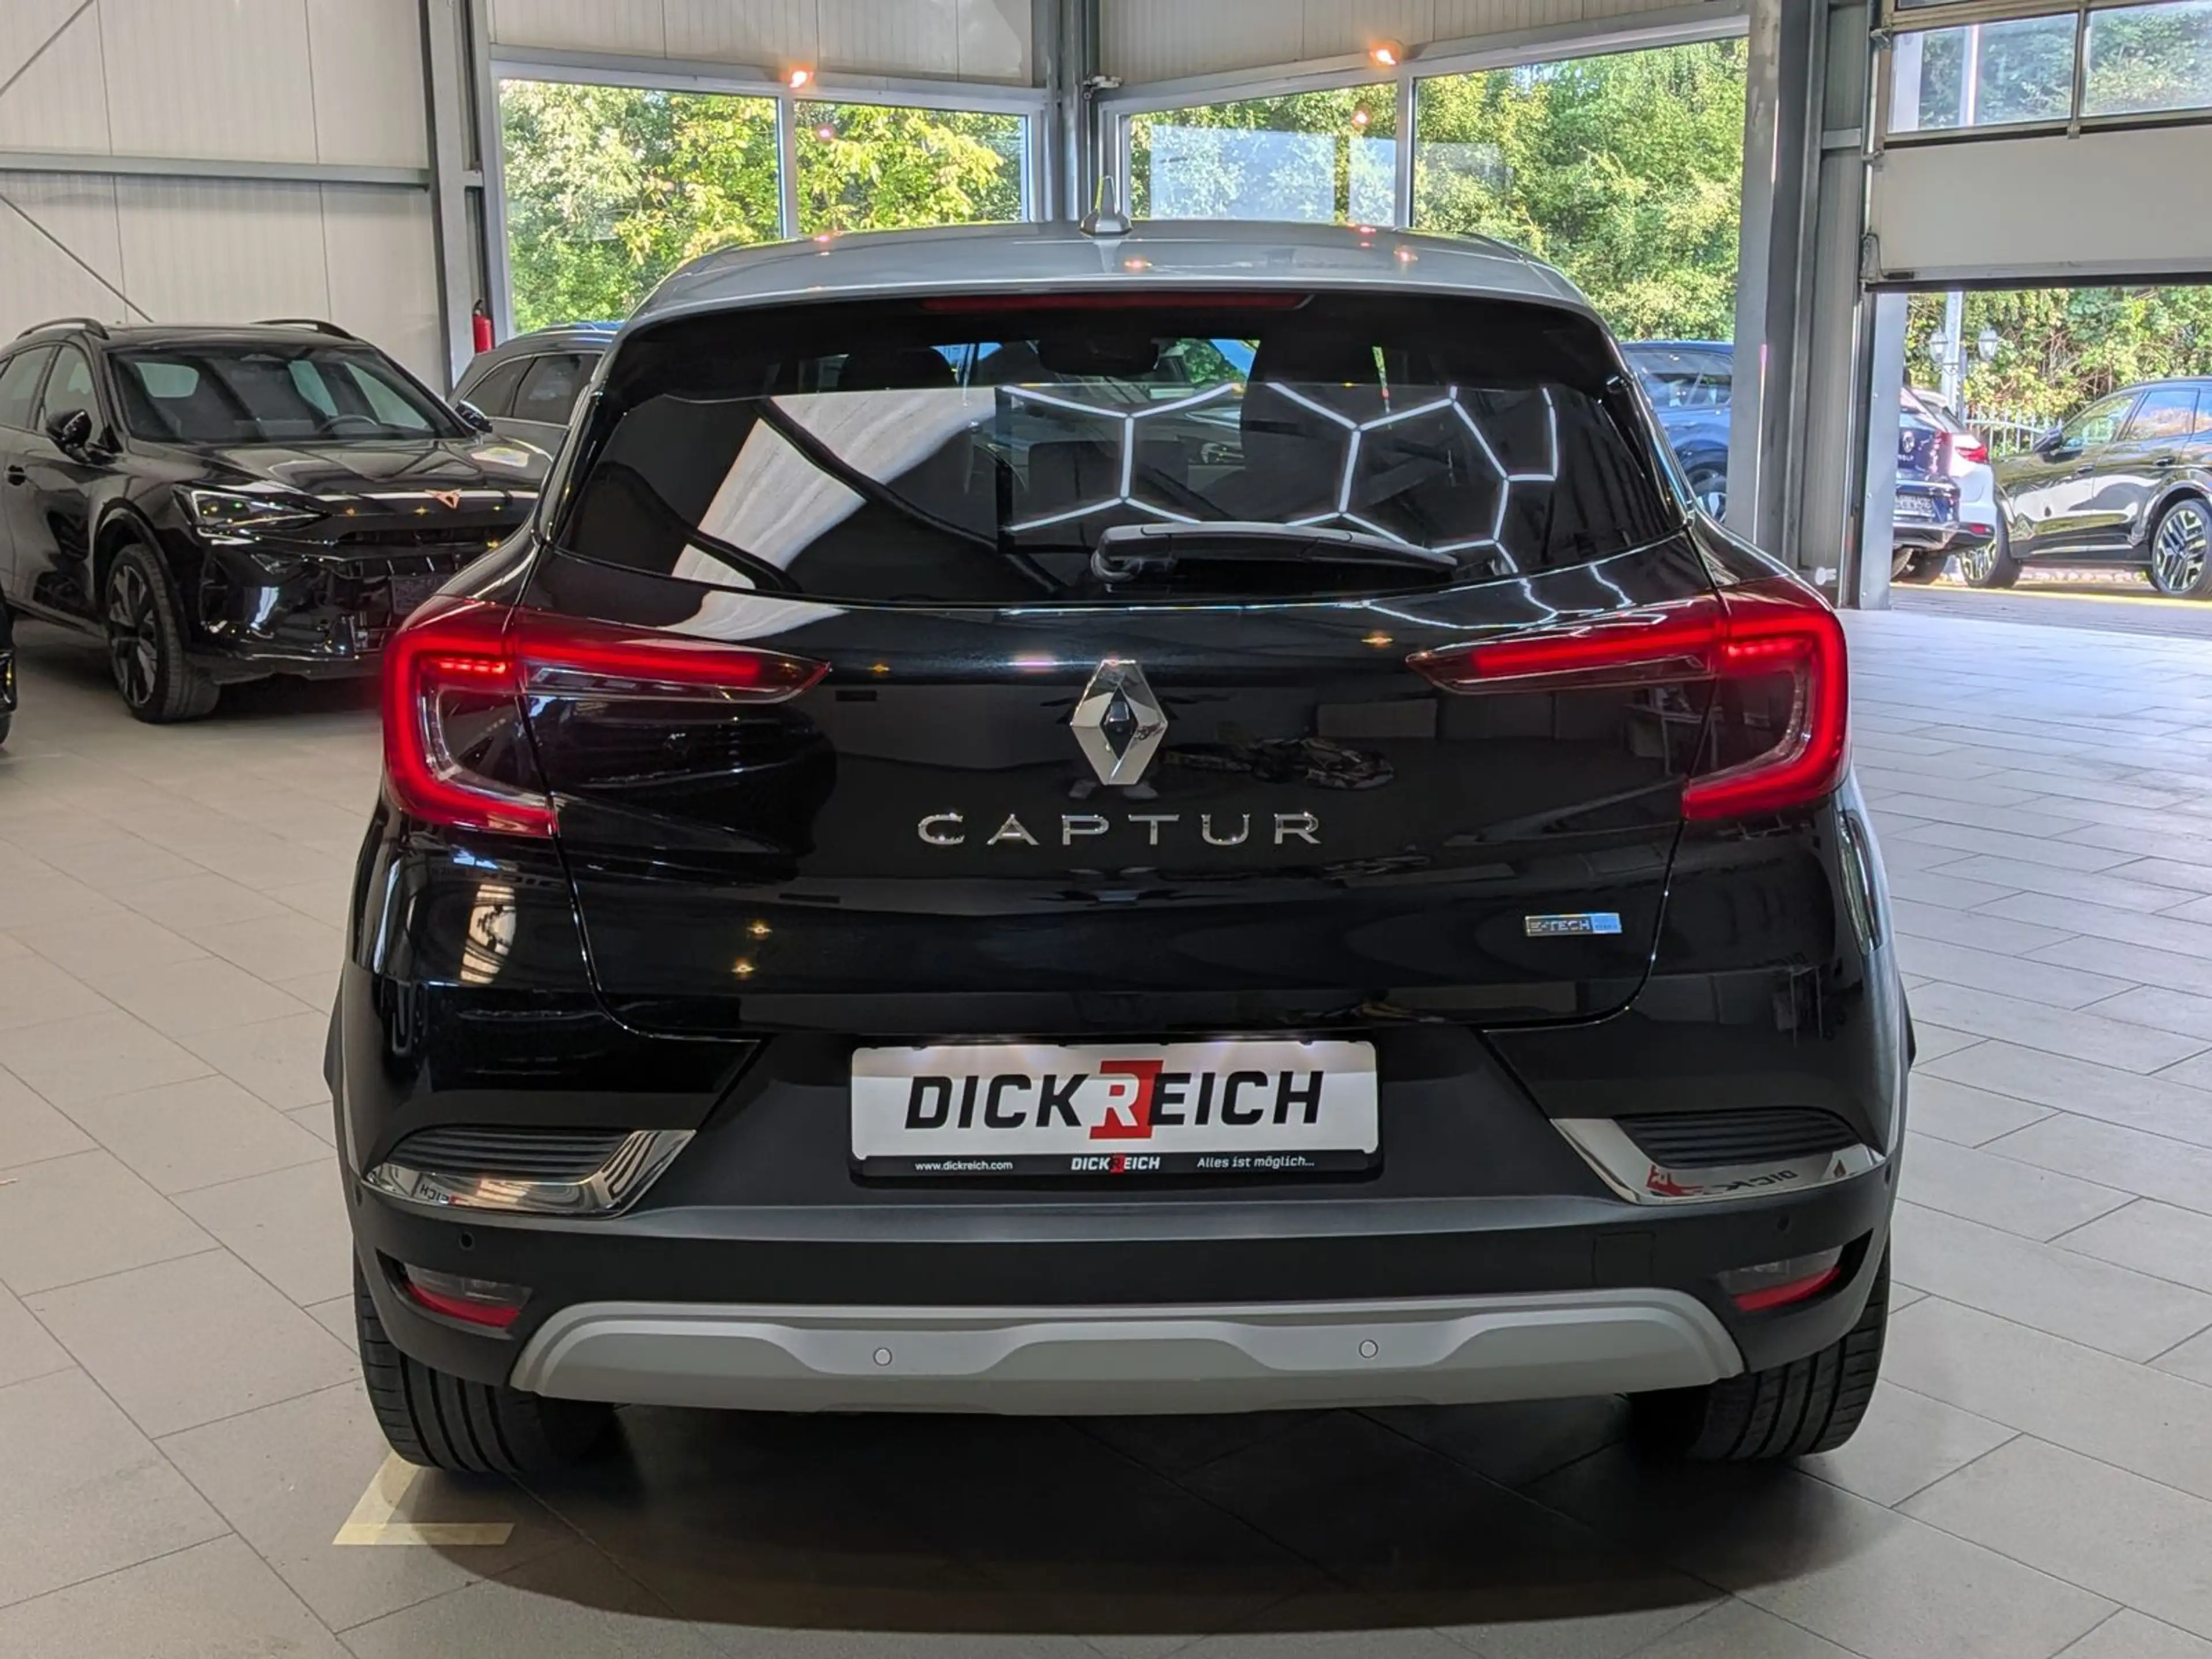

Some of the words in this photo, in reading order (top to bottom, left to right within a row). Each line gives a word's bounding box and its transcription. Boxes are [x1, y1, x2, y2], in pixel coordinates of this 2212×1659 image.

[917, 811, 1321, 845] CAPTUR
[904, 1059, 1324, 1139] DICKREICH
[915, 1160, 1013, 1171] www.dickreich.com
[1070, 1153, 1161, 1173] DICKREICH
[1196, 1157, 1229, 1168] Alles
[1232, 1156, 1252, 1168] ist
